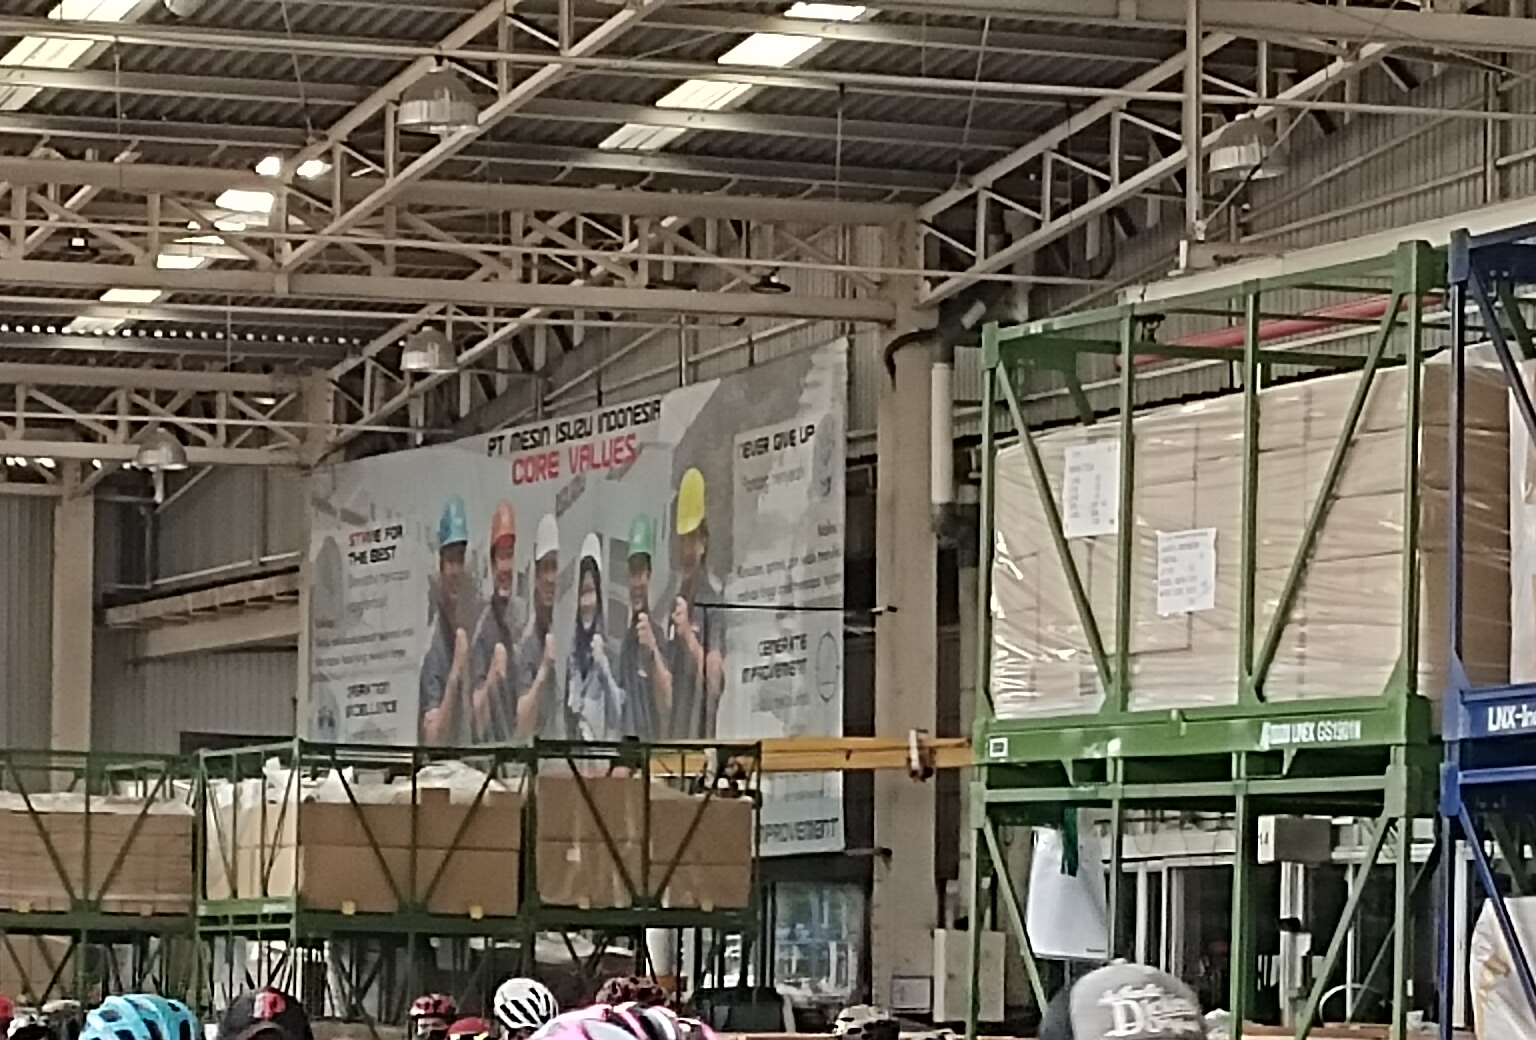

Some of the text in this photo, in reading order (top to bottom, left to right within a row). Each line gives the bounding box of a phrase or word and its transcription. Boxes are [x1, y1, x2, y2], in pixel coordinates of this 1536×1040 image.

[487, 400, 661, 457] PT MESIN ISUZU INDONESIA
[799, 424, 815, 444] UP
[512, 433, 637, 485] CORE VALUES
[370, 546, 396, 563] BEST
